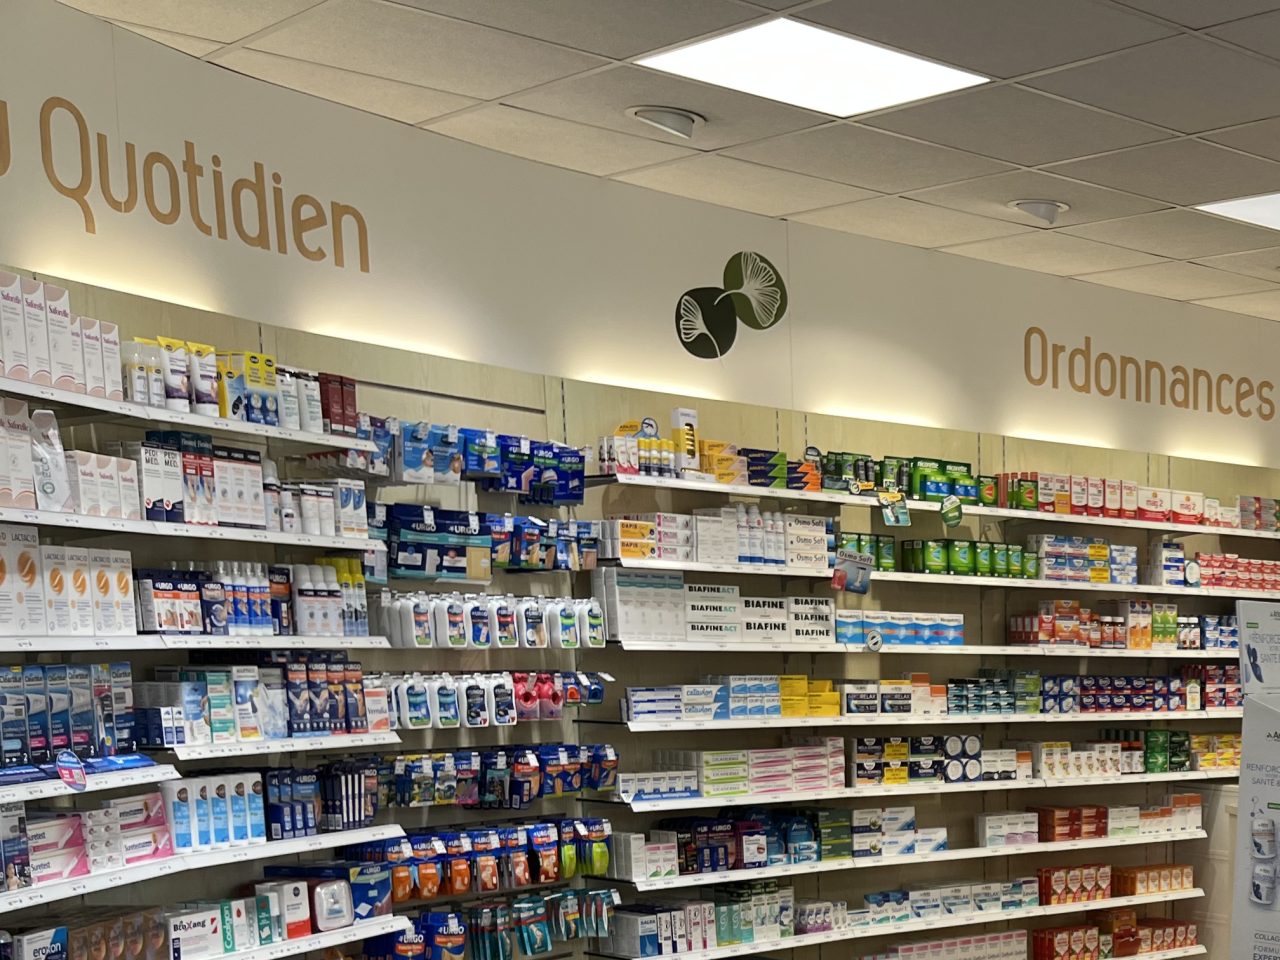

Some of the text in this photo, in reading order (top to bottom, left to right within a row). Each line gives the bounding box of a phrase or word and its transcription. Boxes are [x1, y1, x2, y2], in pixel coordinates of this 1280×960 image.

[39, 96, 370, 273] Quotidien
[1023, 326, 1276, 421] Ordonnances
[794, 518, 825, 527] Osmo Soft
[454, 525, 479, 535] URGO
[796, 536, 826, 544] Osmo Soft
[796, 554, 826, 562] Osmo Soft
[839, 550, 874, 564] Osmo Soft
[744, 600, 785, 610] BIAFINE
[794, 598, 830, 607] BIAFINE
[794, 613, 830, 622] BIAFINE
[745, 622, 787, 631] BIAFINE
[795, 629, 831, 637] BIAFINE
[32, 941, 62, 958] eroxon
